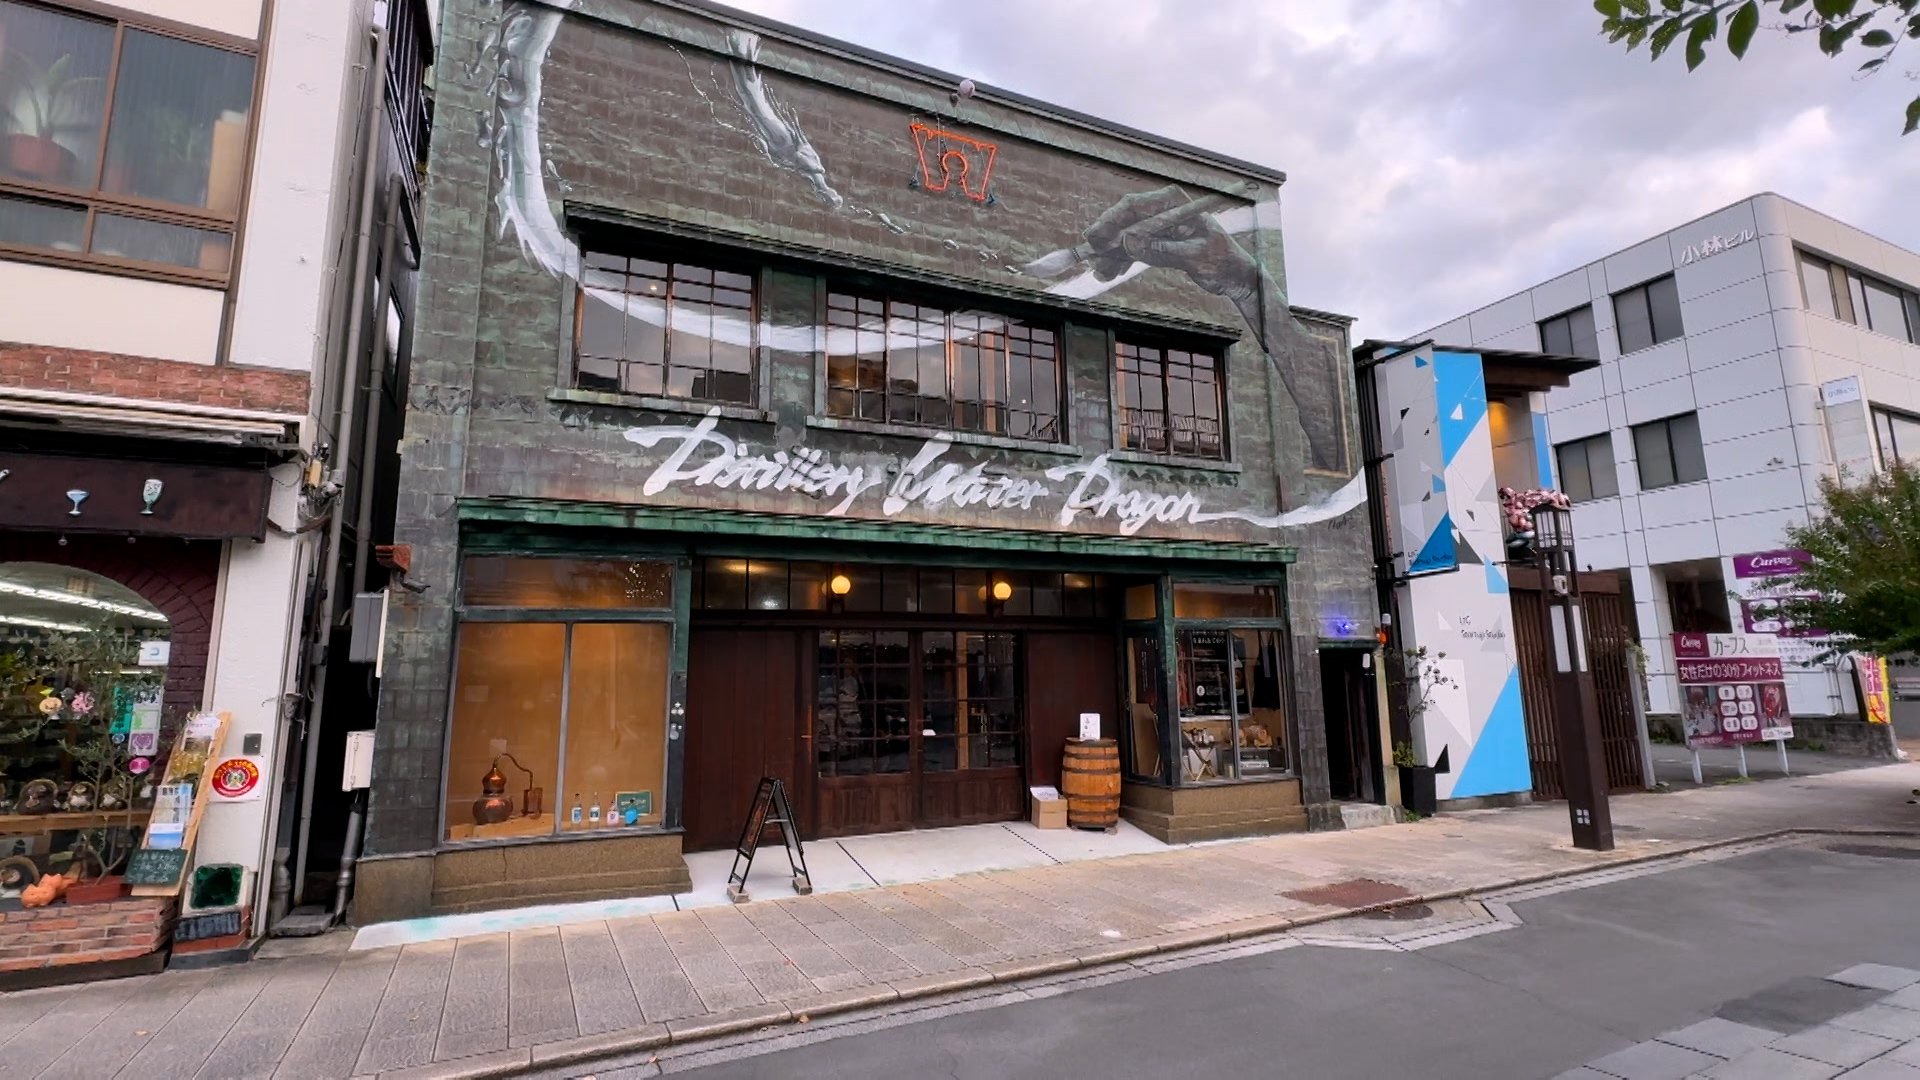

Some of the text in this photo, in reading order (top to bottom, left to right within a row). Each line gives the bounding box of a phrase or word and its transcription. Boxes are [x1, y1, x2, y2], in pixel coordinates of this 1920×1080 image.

[1680, 229, 1755, 265] 小林ビル
[623, 406, 1204, 535] Distillery Water Dragon
